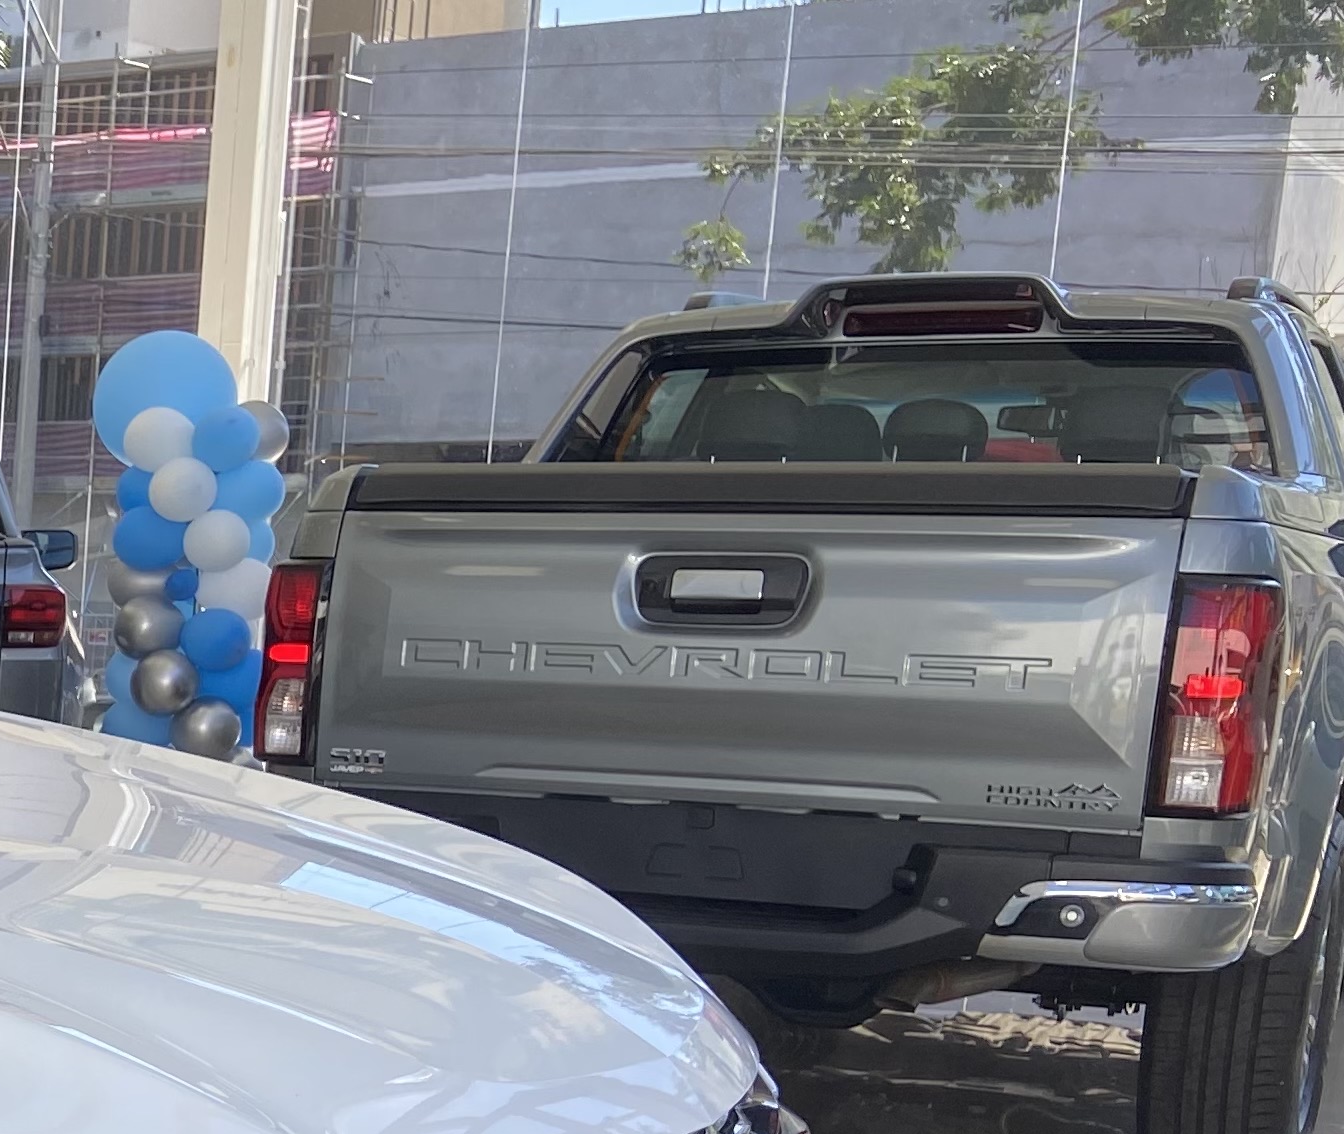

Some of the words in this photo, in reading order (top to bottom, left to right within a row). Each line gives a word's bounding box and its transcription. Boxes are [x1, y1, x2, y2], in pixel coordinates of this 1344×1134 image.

[401, 637, 1052, 691] CHEVROLET
[330, 747, 387, 767] S10
[985, 783, 1054, 797] HIGH
[985, 794, 1119, 812] COUNTRY
